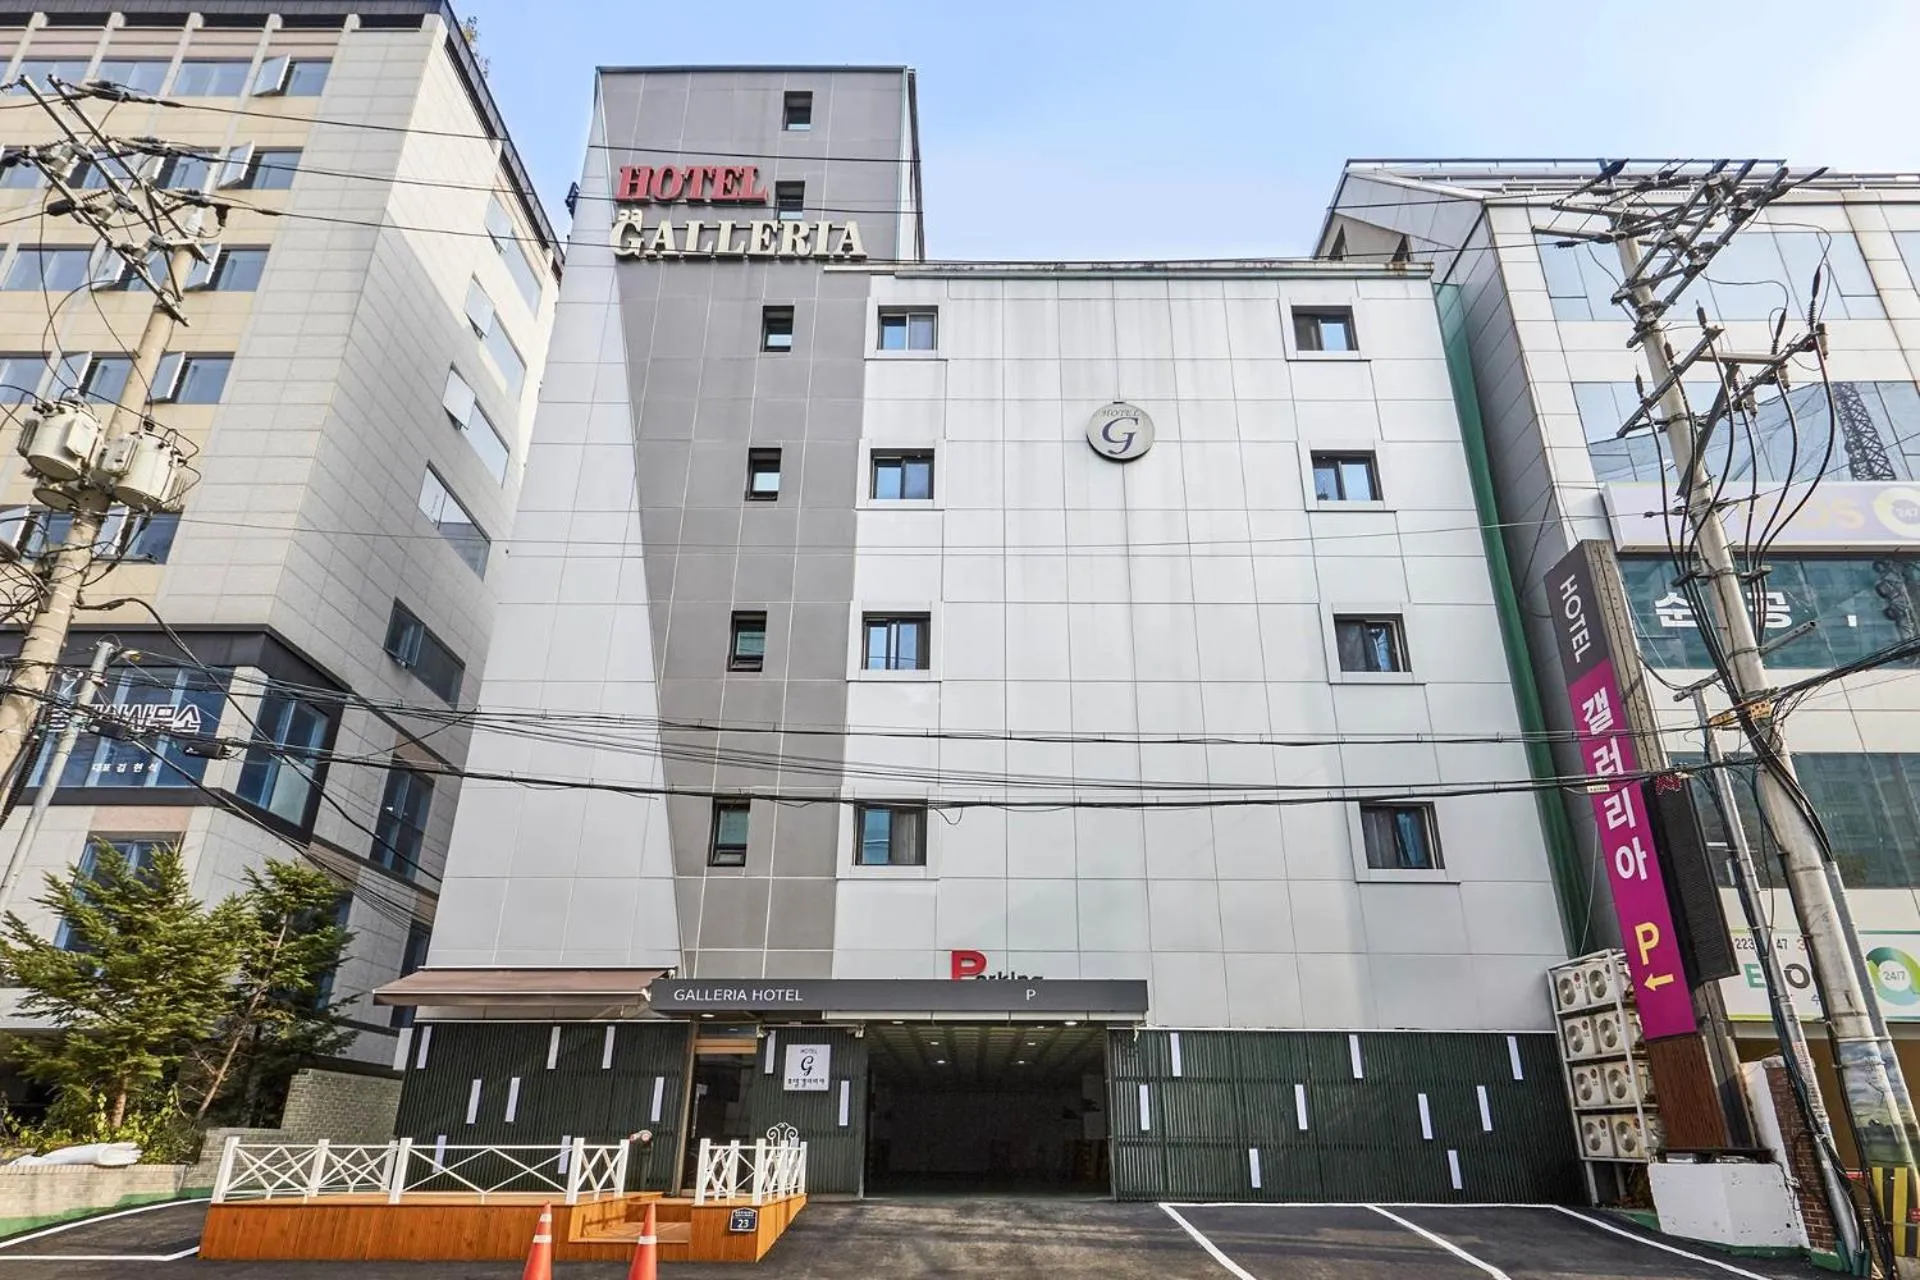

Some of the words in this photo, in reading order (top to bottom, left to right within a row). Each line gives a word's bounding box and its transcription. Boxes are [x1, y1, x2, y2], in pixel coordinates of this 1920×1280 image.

[614, 165, 768, 202] HOTEL
[609, 219, 868, 260] GALLERIA
[1102, 408, 1140, 417] HOTEL
[1101, 416, 1139, 455] G
[1559, 574, 1591, 663] HOTEL
[1582, 687, 1648, 882] 갤러리아
[1634, 921, 1660, 966] P
[673, 988, 748, 1001] GALLERIA
[751, 988, 804, 1001] HOTEL
[1025, 988, 1037, 1001] P
[800, 1055, 814, 1076] G
[737, 1219, 750, 1229] 23
